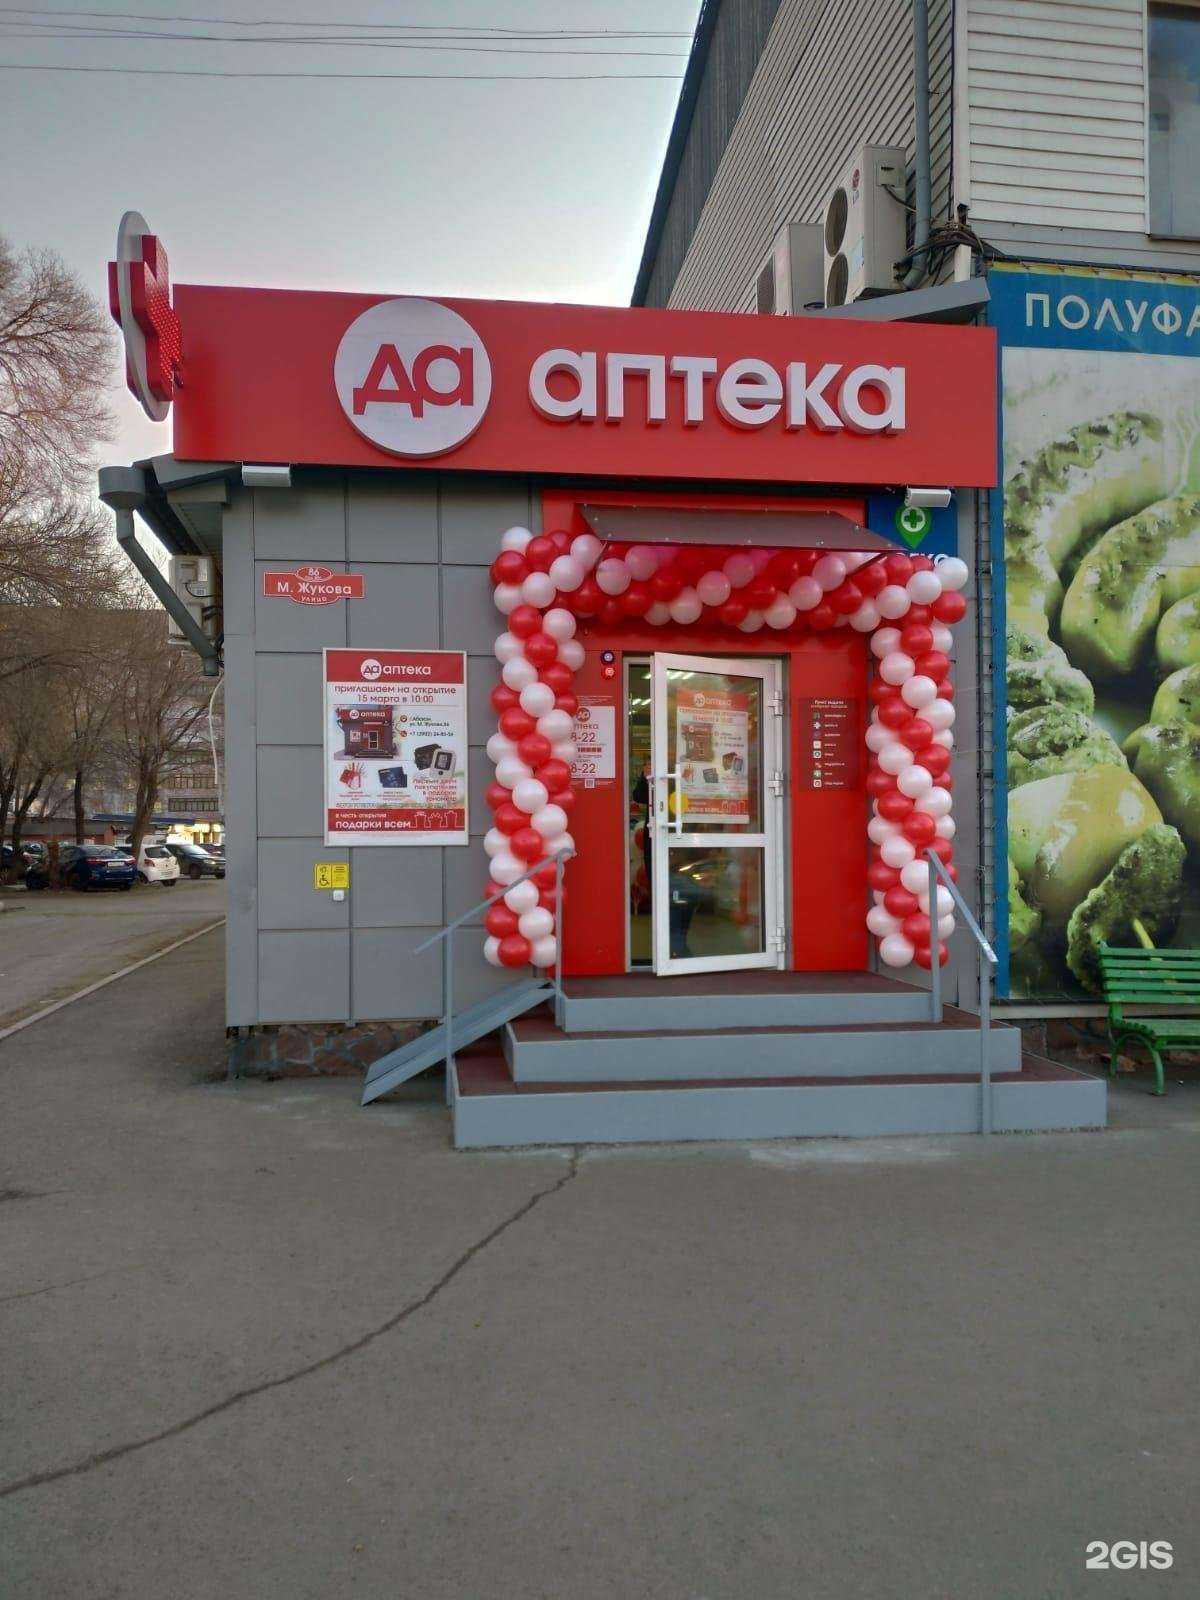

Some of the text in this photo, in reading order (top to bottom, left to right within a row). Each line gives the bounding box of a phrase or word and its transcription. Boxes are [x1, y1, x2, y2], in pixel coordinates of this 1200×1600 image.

[529, 348, 906, 435] аптека
[277, 582, 352, 595] М. Жукова
[383, 665, 431, 675] аптека
[334, 685, 395, 693] приглашаем
[412, 686, 456, 694] открытие
[370, 696, 400, 704] марта
[411, 695, 434, 703] 10:00
[335, 820, 411, 831] подарки всем
